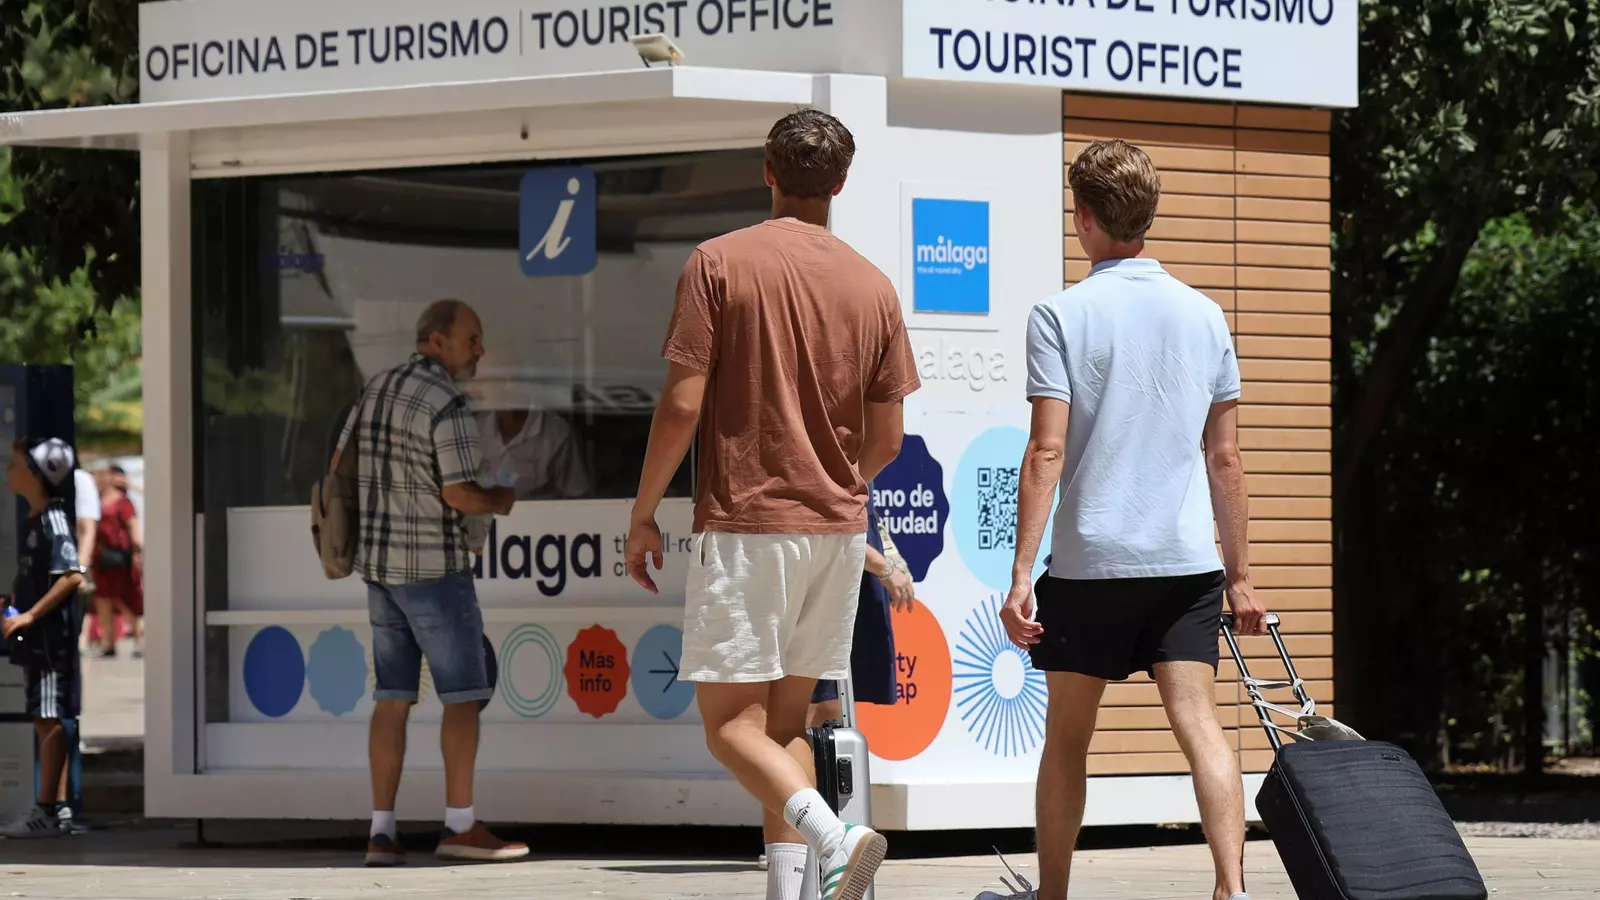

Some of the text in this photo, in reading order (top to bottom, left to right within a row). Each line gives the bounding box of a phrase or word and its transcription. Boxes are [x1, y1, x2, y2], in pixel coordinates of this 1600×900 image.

[145, 0, 834, 82] OFICINA DE TURISMO TOURIST OFFICE
[929, 27, 1243, 89] TOURIST OFFICE
[872, 483, 935, 508] ano de
[473, 517, 602, 597] laga
[579, 649, 615, 669] Más
[895, 652, 918, 679] ty
[579, 673, 613, 693] info
[895, 682, 918, 706] ap
